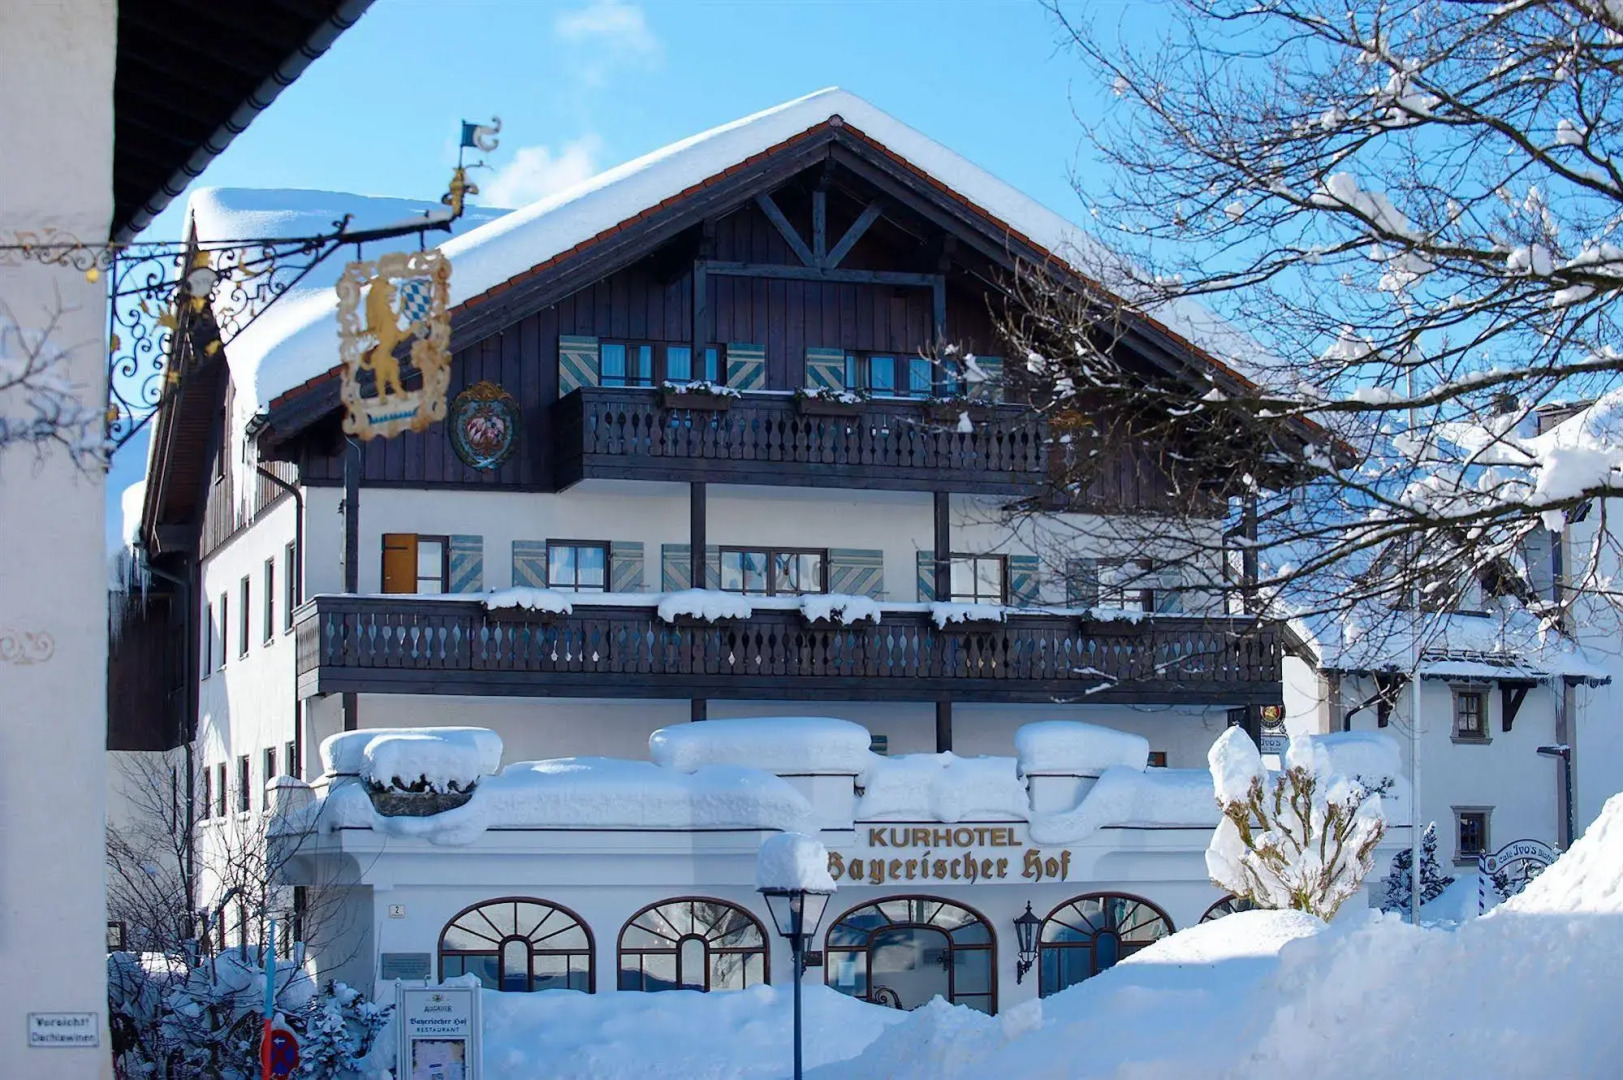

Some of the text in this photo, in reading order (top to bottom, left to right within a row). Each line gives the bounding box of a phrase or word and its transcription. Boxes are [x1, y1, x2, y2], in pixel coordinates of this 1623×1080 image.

[869, 827, 1023, 848] KURHOTEL
[827, 848, 1072, 885] Bayerischer Hof
